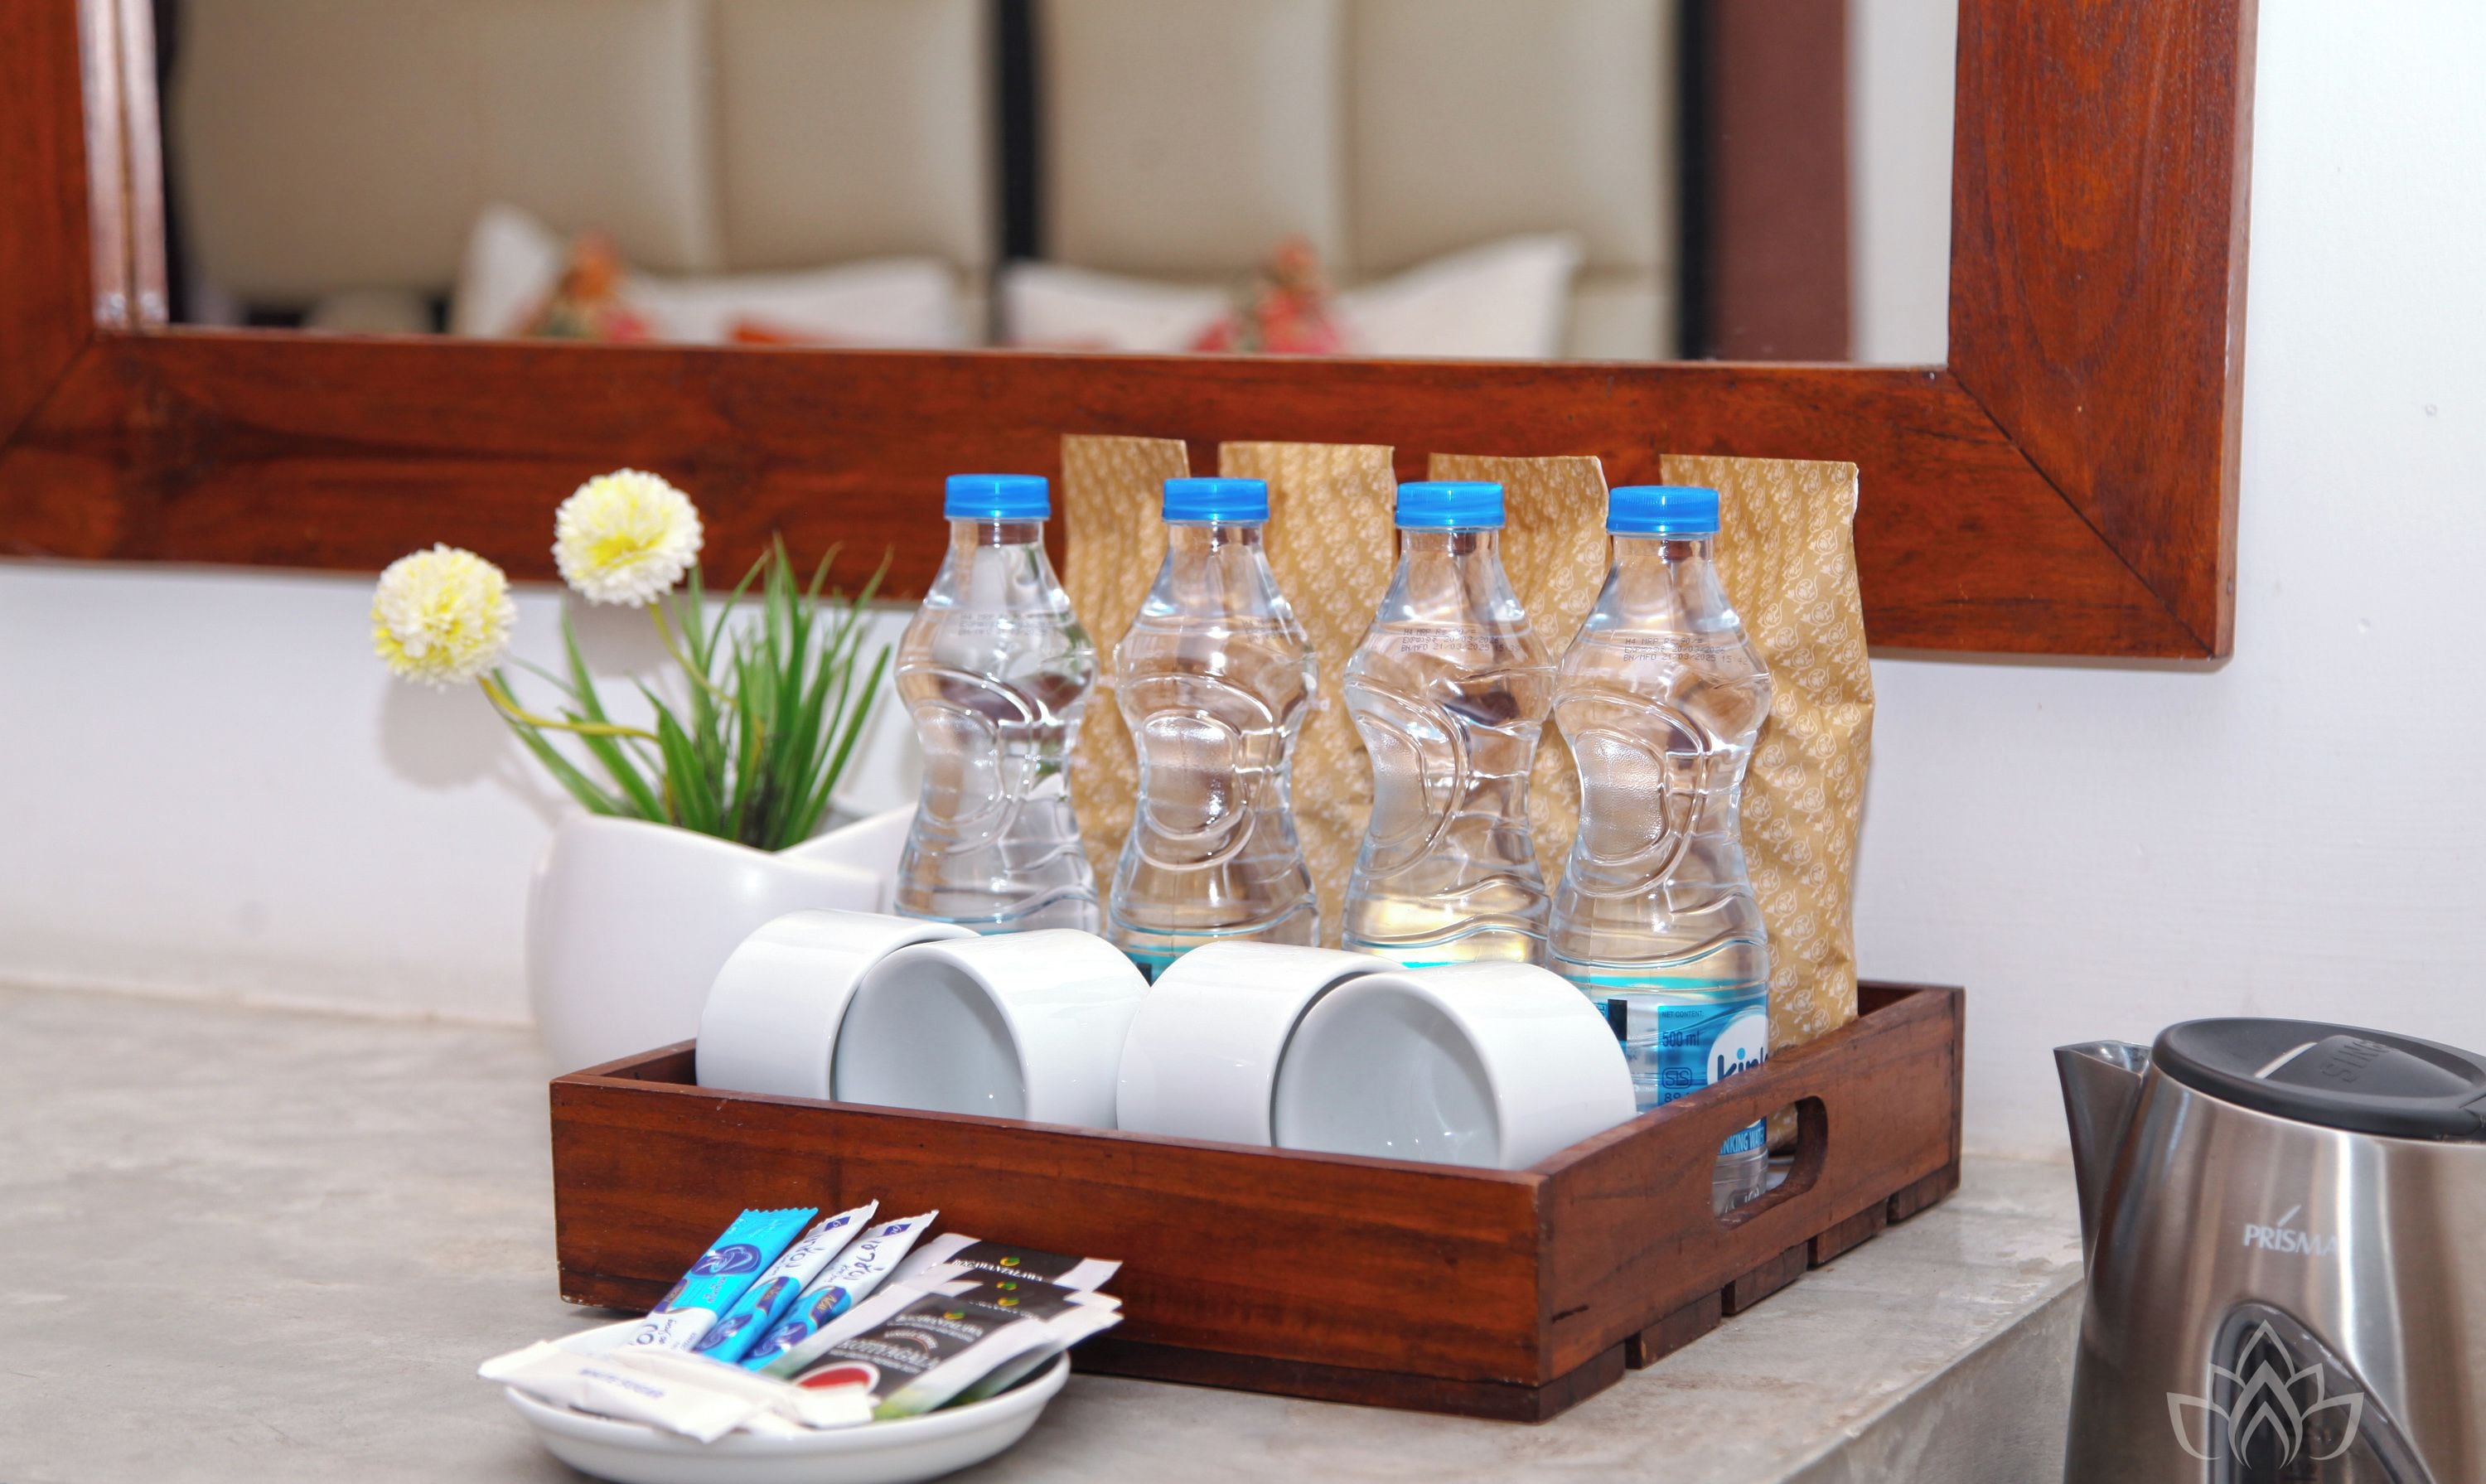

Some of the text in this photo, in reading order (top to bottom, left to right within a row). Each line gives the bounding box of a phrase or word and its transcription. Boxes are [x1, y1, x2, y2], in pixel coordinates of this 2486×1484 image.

[1661, 1010, 1674, 1018] NET
[1661, 1030, 1700, 1047] 500 ml
[1664, 1069, 1690, 1087] SLS
[1664, 1092, 1690, 1104] 89
